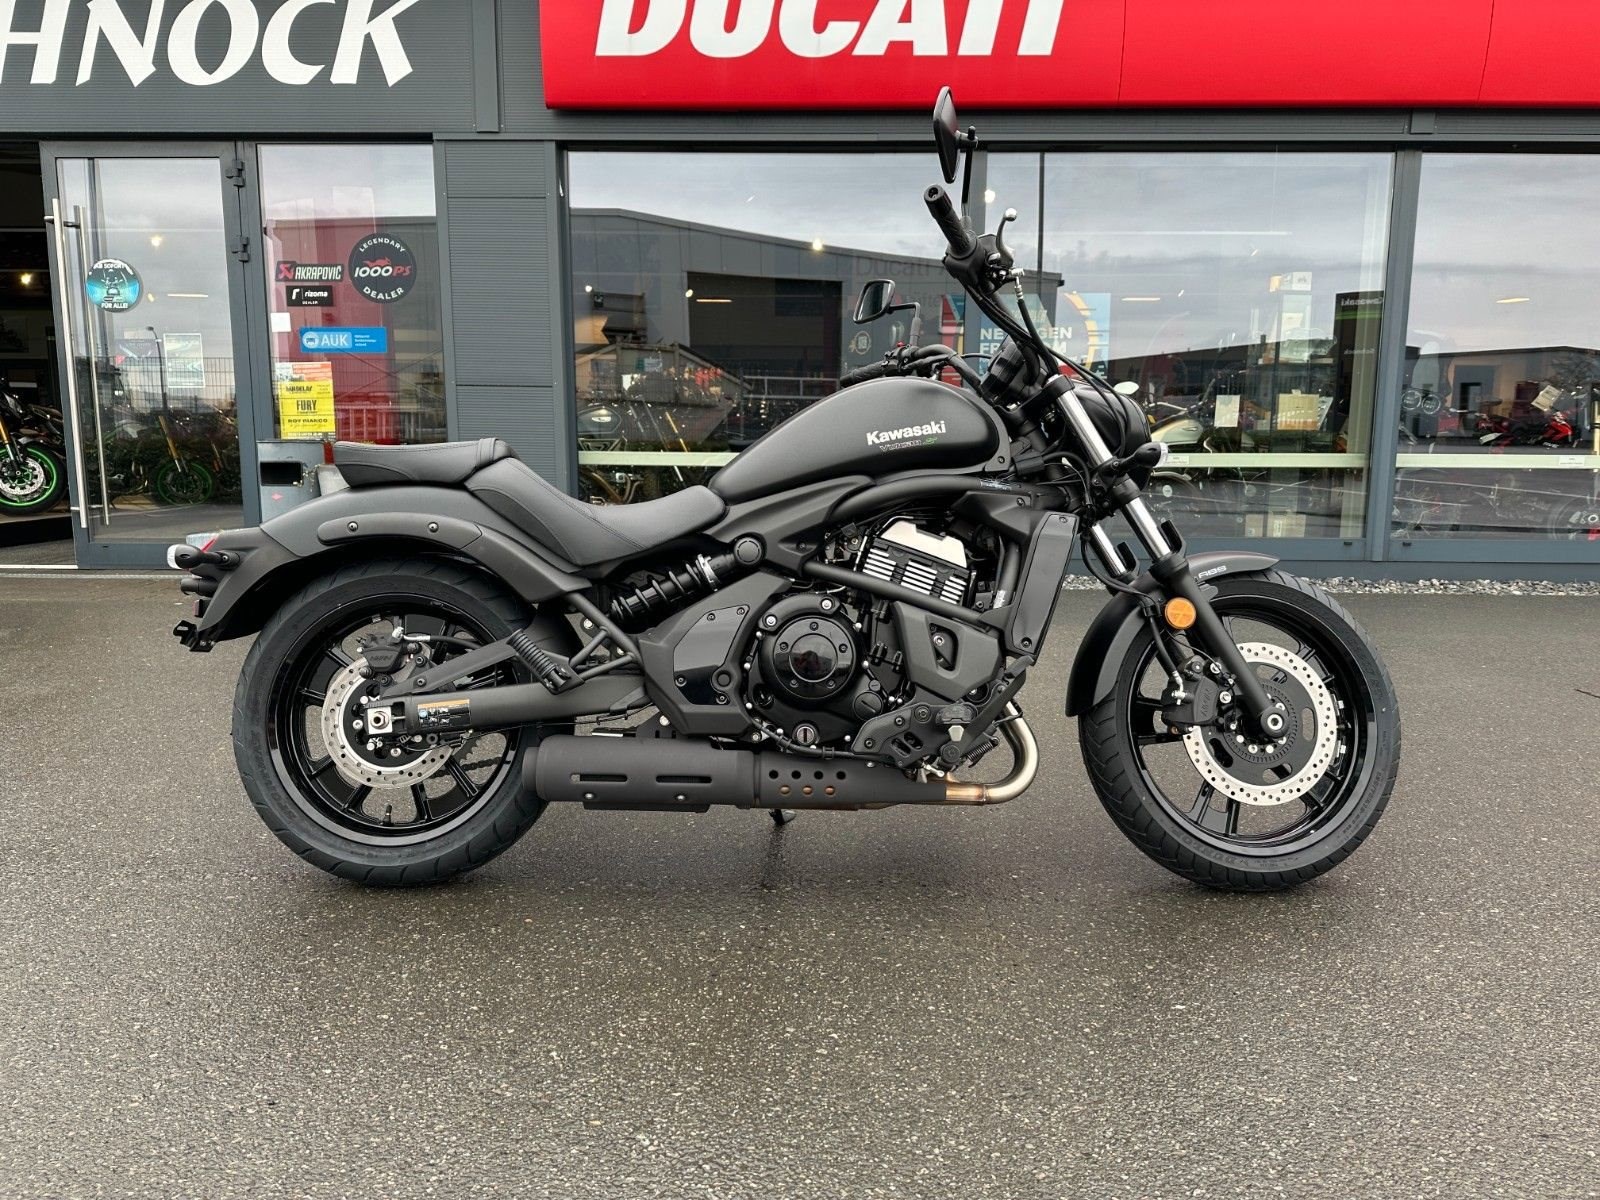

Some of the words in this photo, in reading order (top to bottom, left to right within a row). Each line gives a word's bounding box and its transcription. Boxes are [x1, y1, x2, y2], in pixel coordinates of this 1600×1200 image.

[359, 237, 406, 252] LEGENDARY
[354, 265, 411, 278] 1000PS
[363, 286, 404, 300] DEALER
[321, 334, 349, 347] AUK
[296, 399, 317, 411] FURY
[866, 420, 946, 446] Kawasaki
[1198, 565, 1227, 579] ABS
